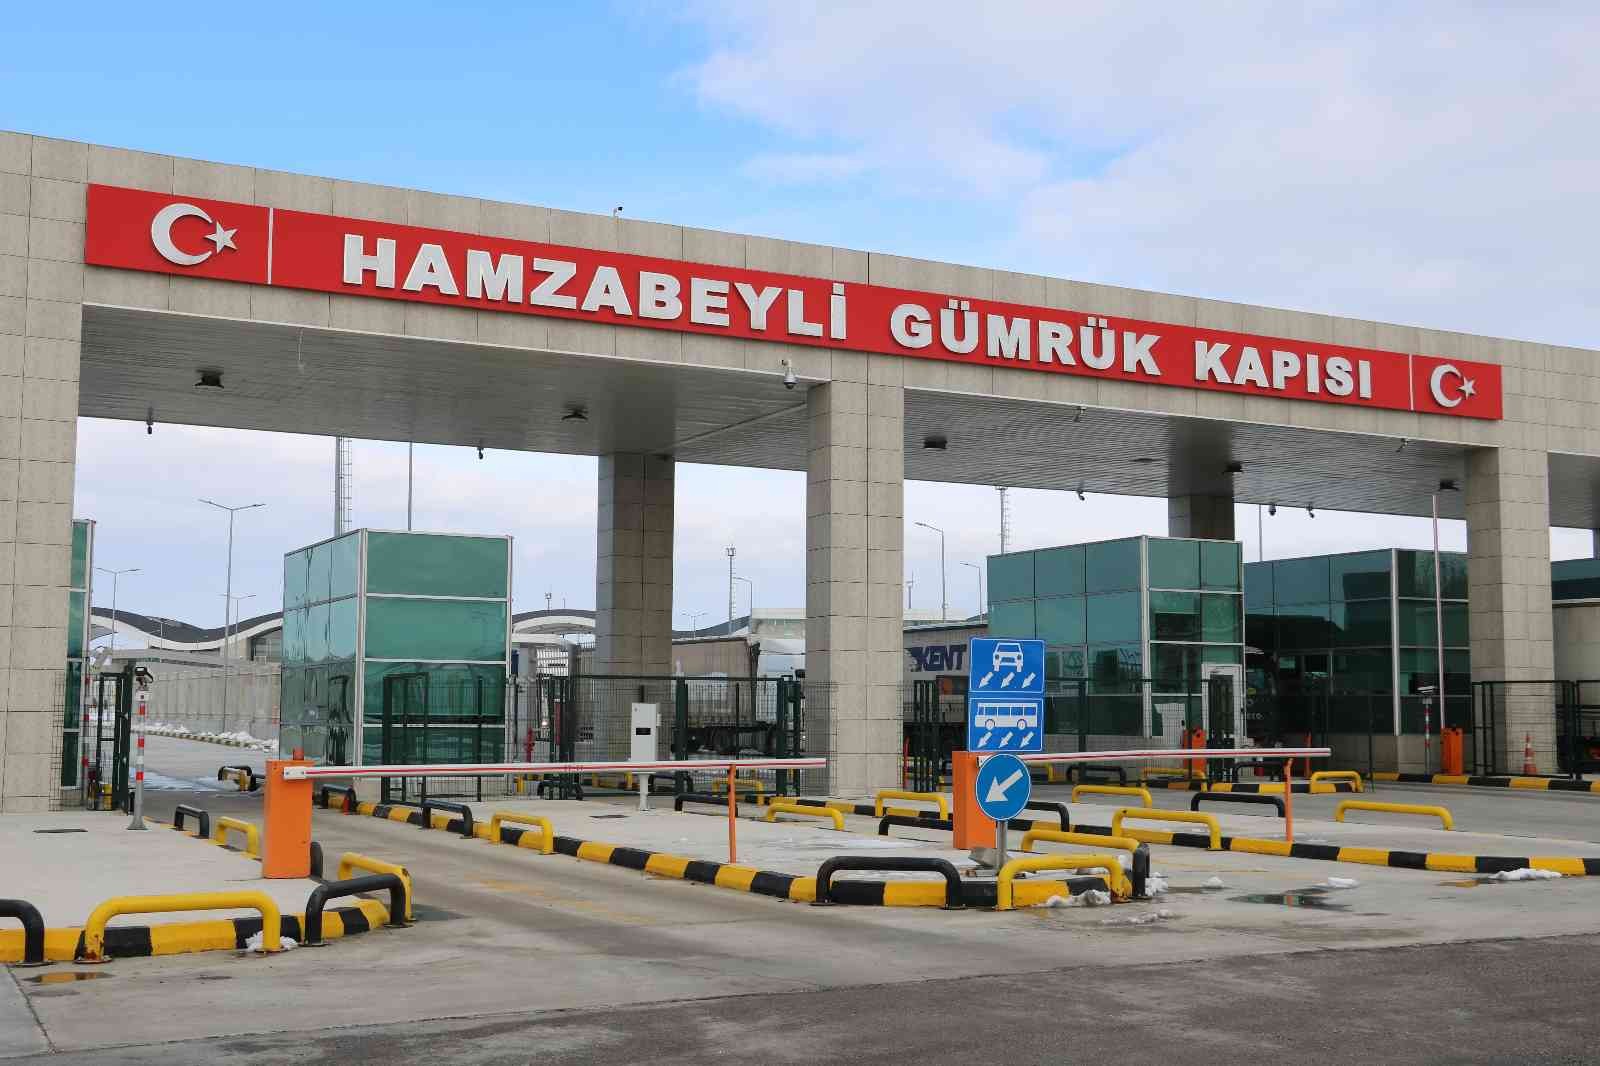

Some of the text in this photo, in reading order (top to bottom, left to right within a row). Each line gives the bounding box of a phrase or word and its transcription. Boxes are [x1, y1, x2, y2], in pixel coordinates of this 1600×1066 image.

[343, 233, 1372, 399] HAMZABEYLİ GÜMRÜK KAPISI
